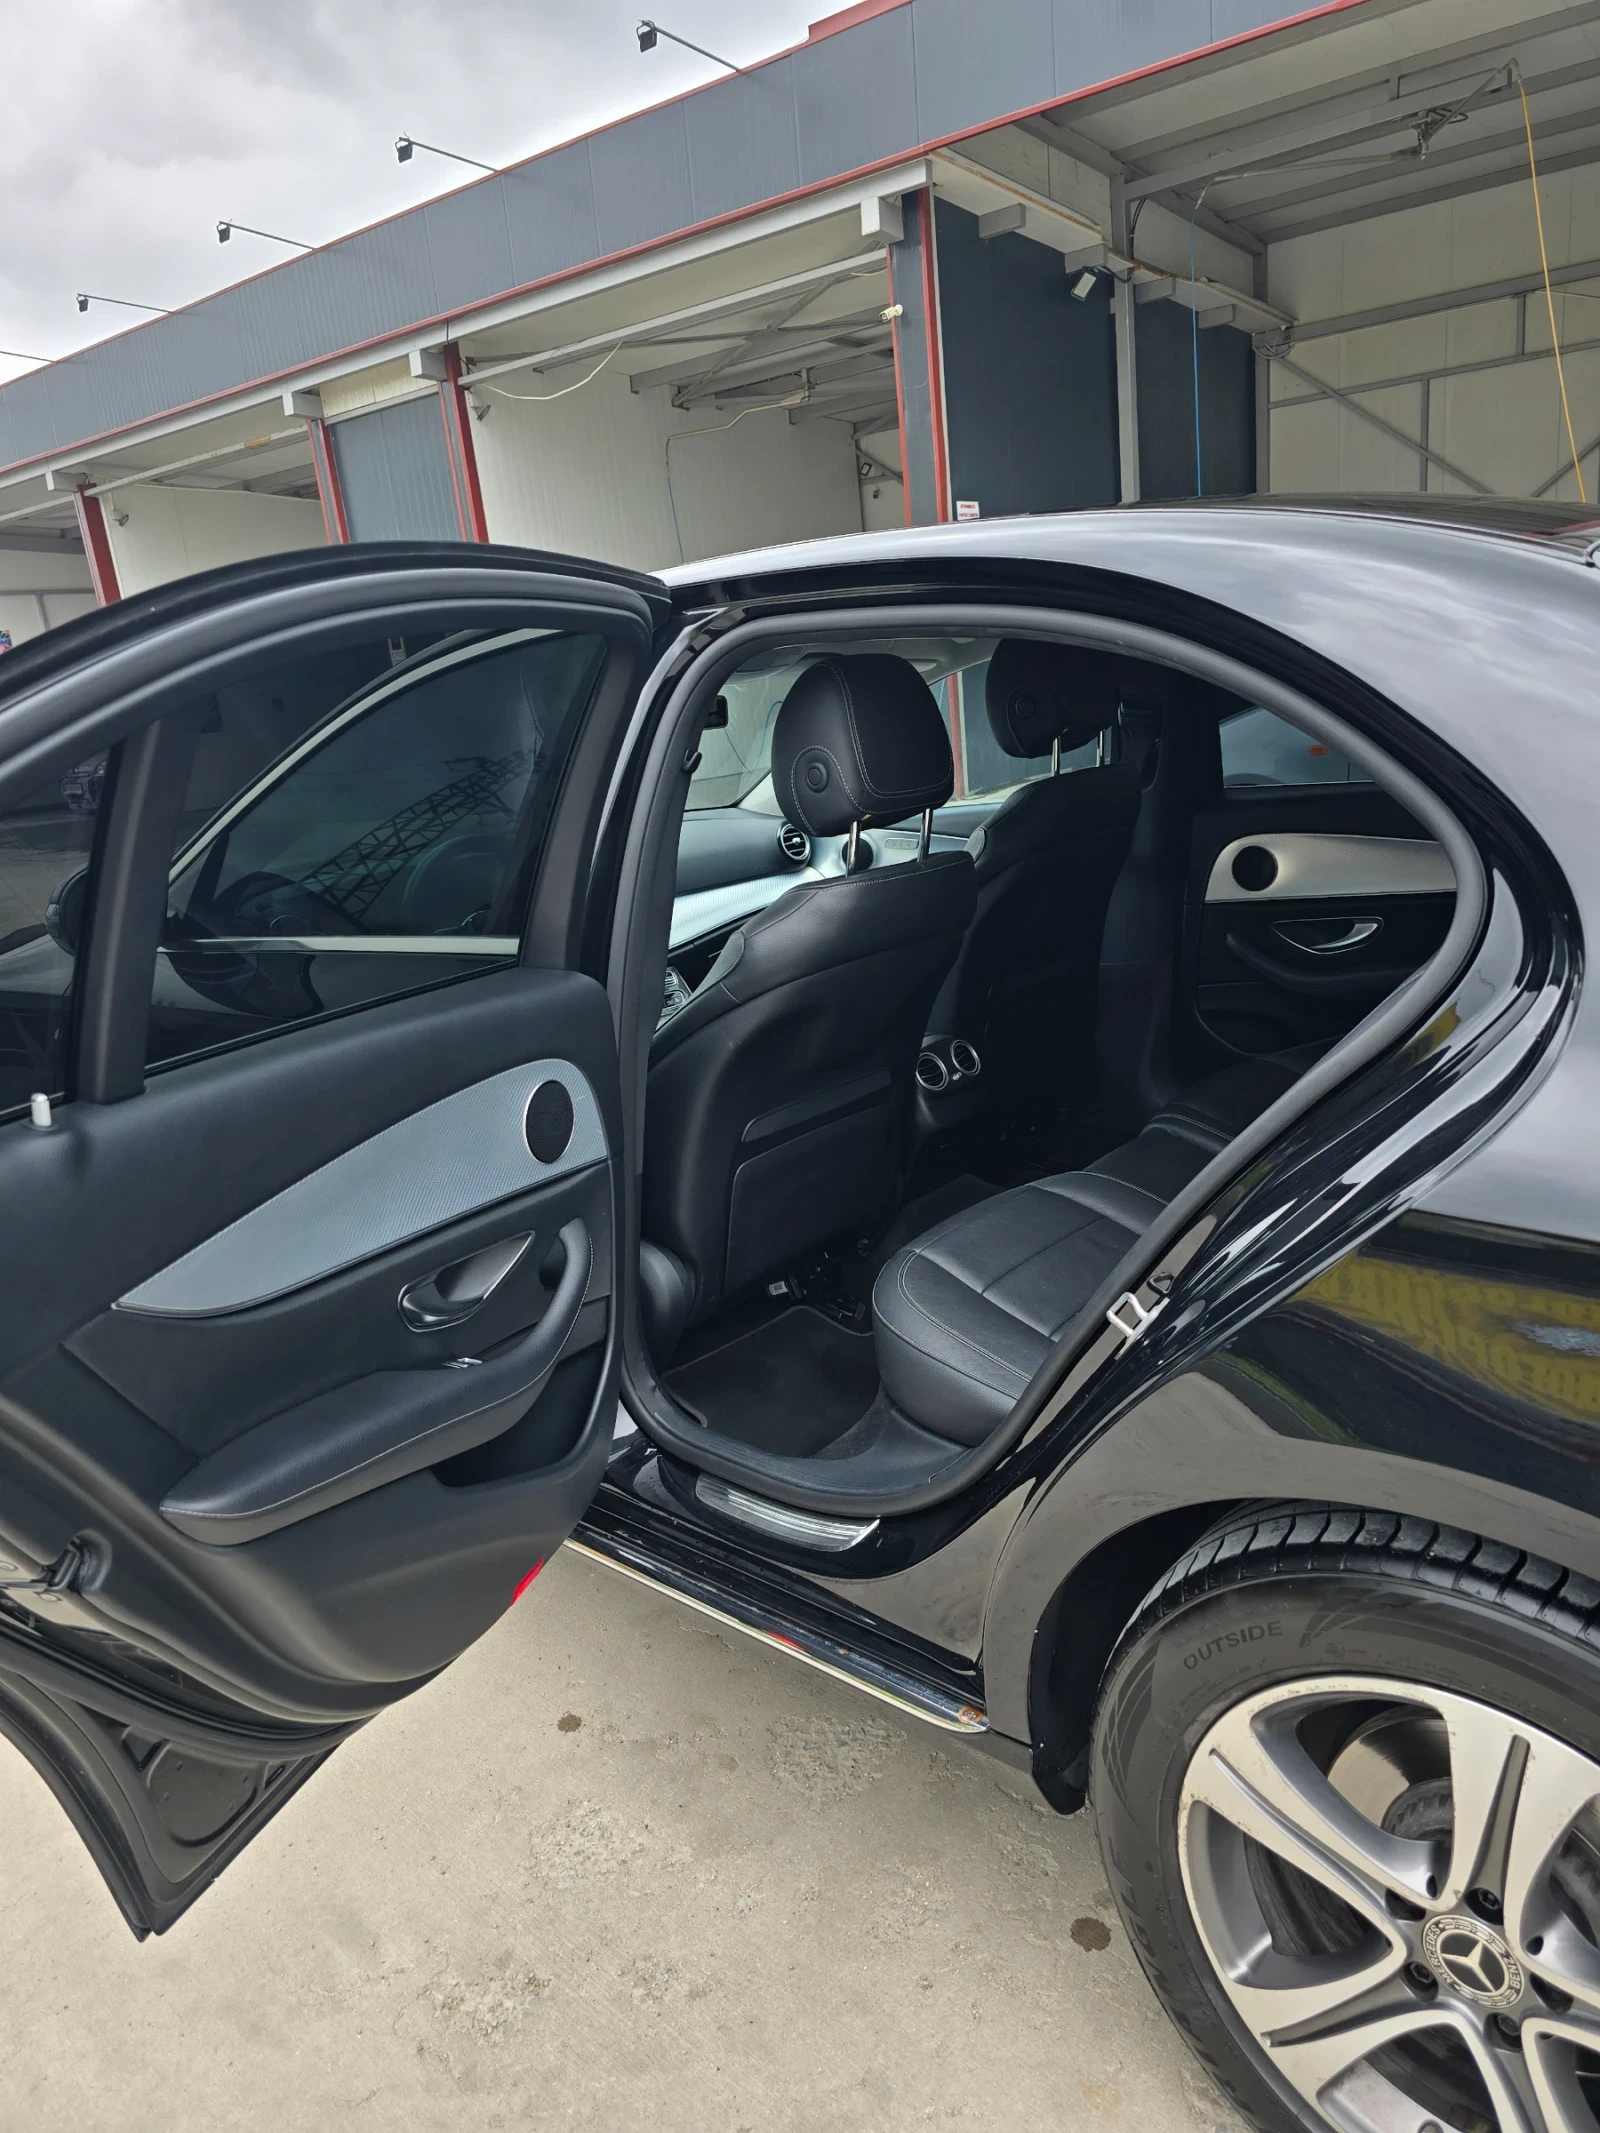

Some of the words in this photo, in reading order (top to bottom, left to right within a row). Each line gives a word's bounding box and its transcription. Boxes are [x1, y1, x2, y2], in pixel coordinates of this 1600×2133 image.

[1183, 1620, 1284, 1670] OUTSIDE
[1426, 1924, 1453, 1984] MERCEDES
[1502, 1956, 1521, 1989] BENZ
